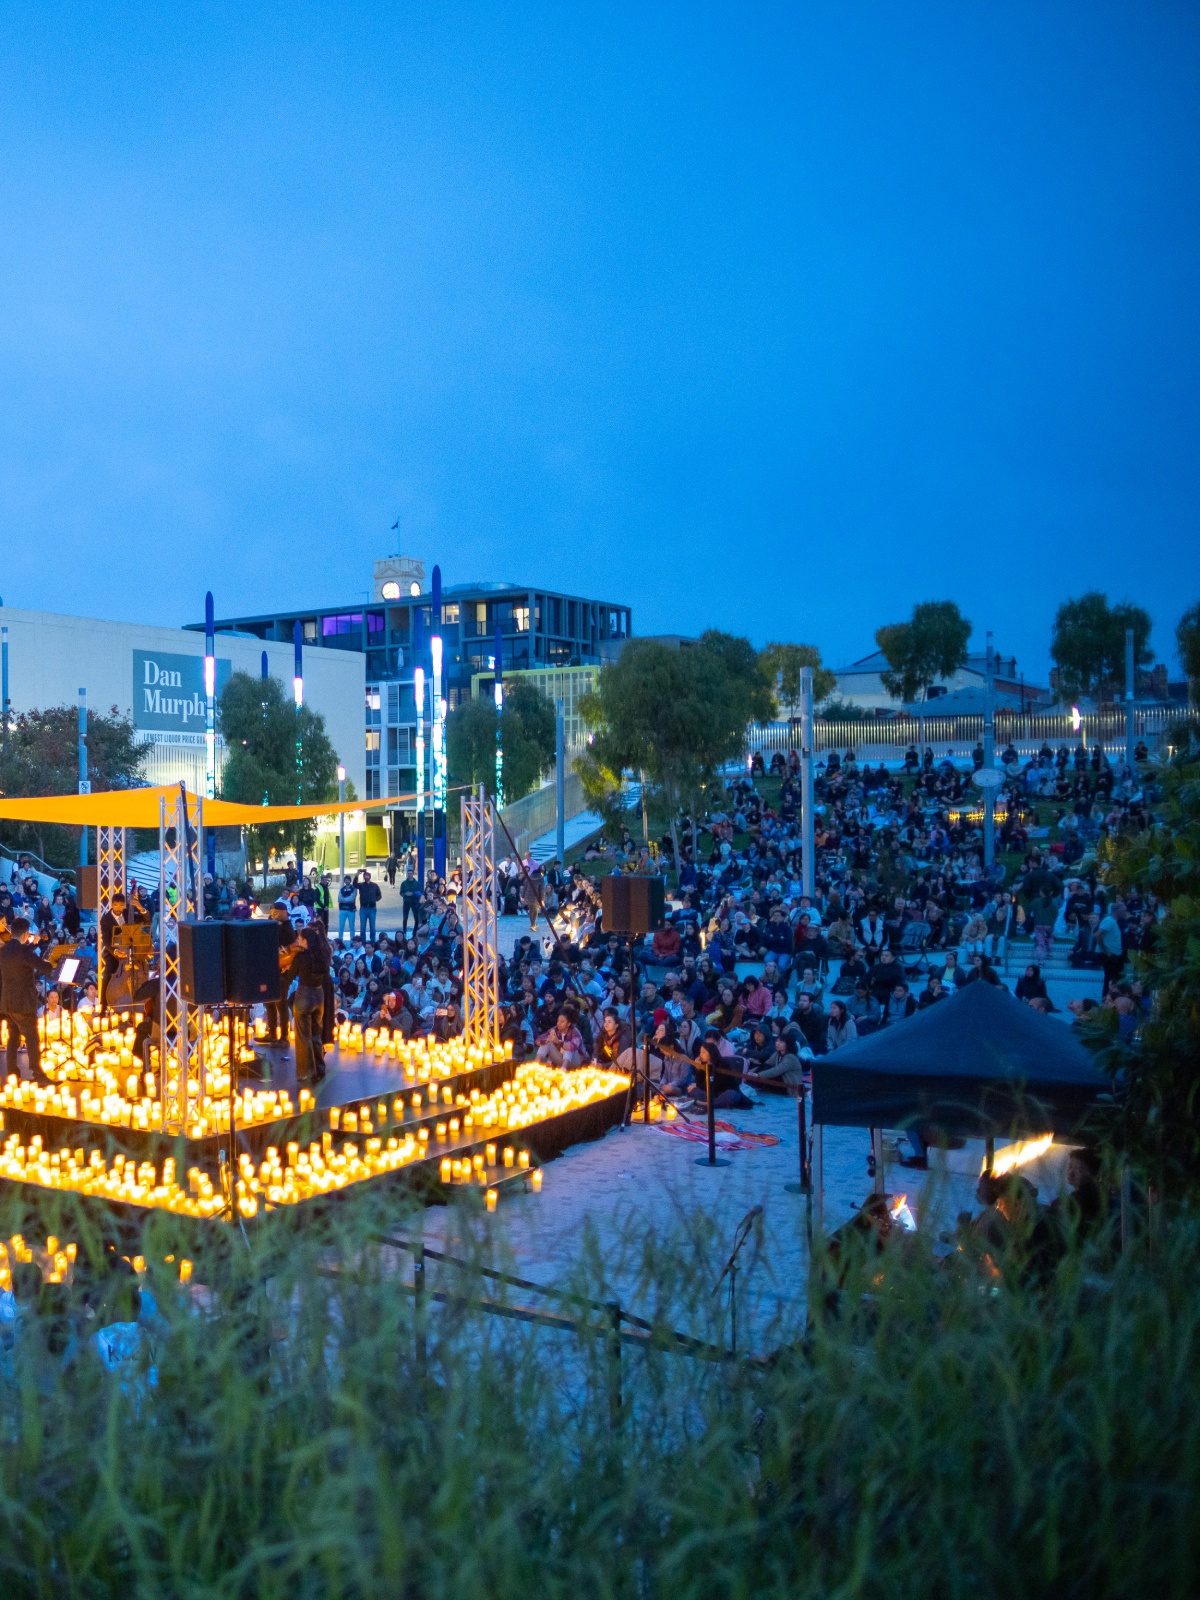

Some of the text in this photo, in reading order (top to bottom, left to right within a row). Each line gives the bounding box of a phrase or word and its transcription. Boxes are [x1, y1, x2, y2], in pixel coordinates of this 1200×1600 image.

[143, 660, 182, 687] Dan
[143, 733, 163, 742] LOWEST
[164, 734, 181, 744] LIQUOR
[182, 735, 195, 744] PRICE
